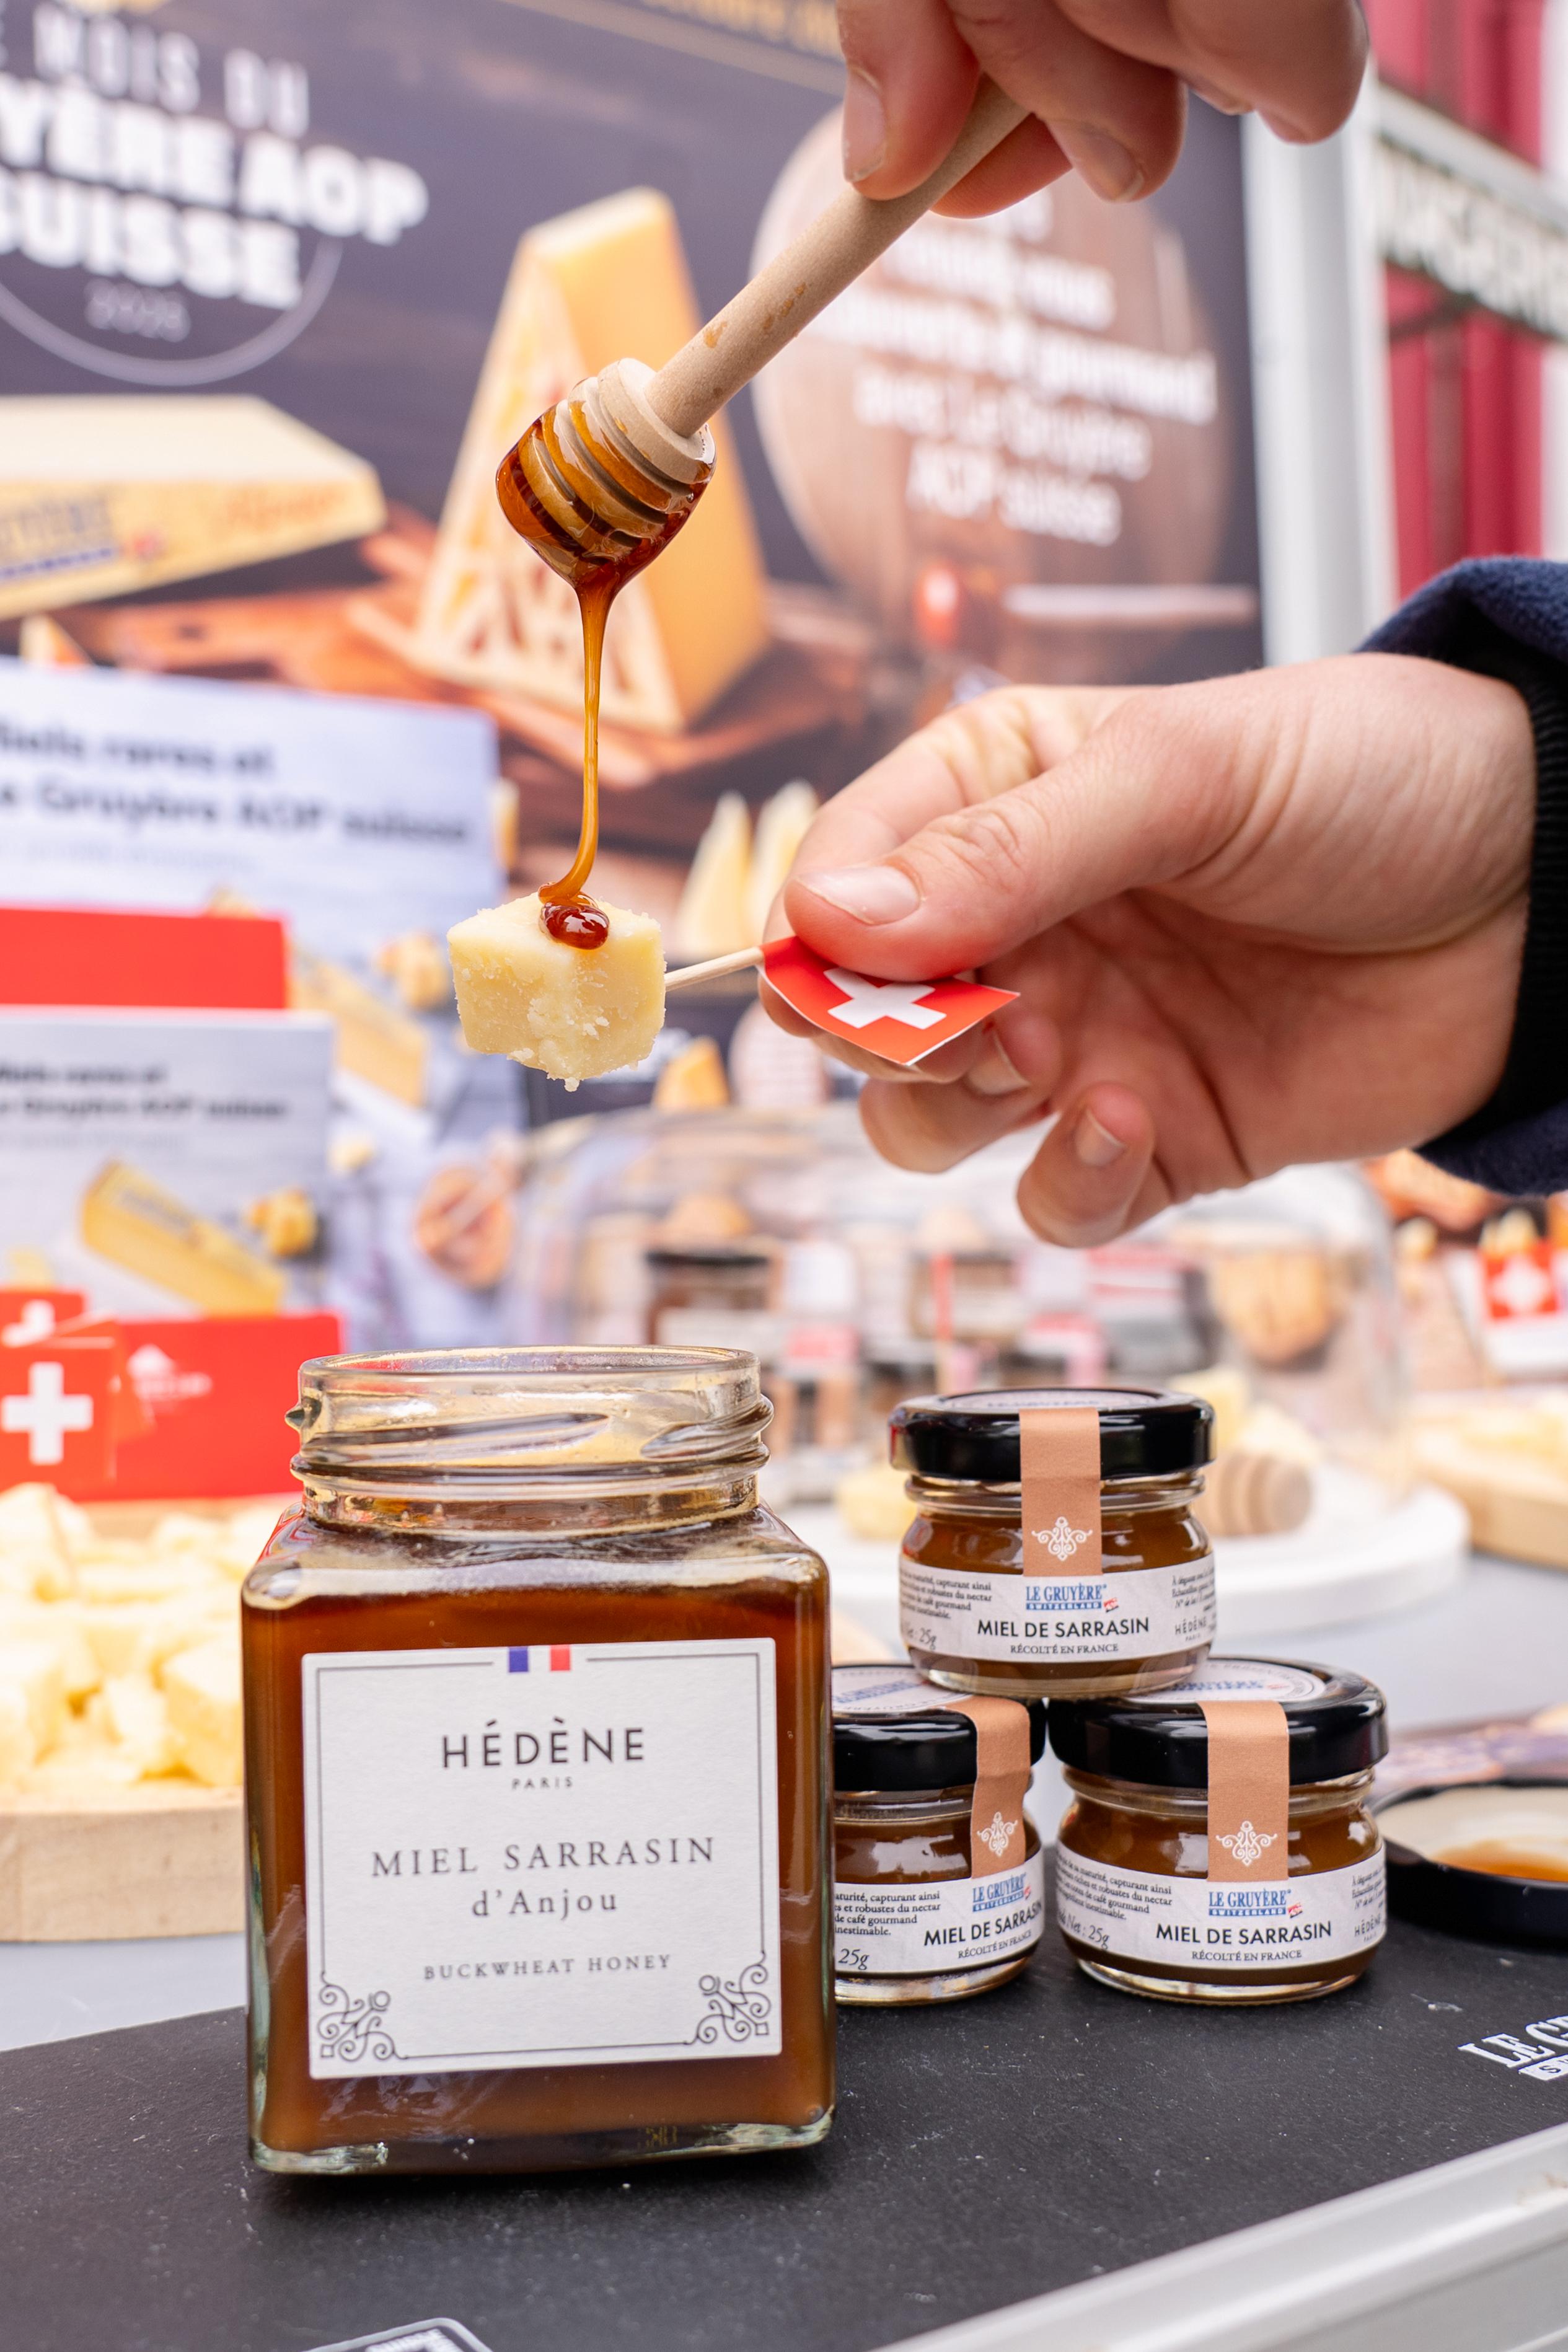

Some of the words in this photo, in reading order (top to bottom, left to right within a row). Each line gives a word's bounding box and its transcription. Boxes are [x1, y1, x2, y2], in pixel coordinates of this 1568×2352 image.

[239, 130, 429, 246] AOP
[972, 1582, 992, 1590] ainsi
[1026, 1586, 1041, 1601] LE
[955, 1591, 964, 1599] du
[935, 1600, 971, 1611] gourmand
[977, 1619, 1018, 1637] MIEL
[1024, 1622, 1049, 1637] DE
[1055, 1617, 1148, 1637] SARRASIN
[919, 1627, 936, 1650] 25g
[1011, 1642, 1057, 1654] RÉCOLTÉ
[1061, 1645, 1075, 1654] EN
[1078, 1643, 1119, 1654] FRANCE
[443, 1716, 645, 1769] HÉDÈNE
[512, 1776, 573, 1790] PARIS
[371, 1847, 478, 1877] MIEL
[504, 1836, 715, 1871] SARRASIN
[1109, 1876, 1148, 1890] capturant
[1150, 1885, 1171, 1895] ainsi
[870, 1893, 916, 1905] capturant
[918, 1890, 940, 1900] ainsi
[972, 1886, 985, 1903] LE
[1098, 1885, 1130, 1898] robustes
[1132, 1892, 1142, 1901] du
[1145, 1895, 1173, 1906] nectar
[1209, 1891, 1224, 1907] LE
[855, 1903, 895, 1913] robustes
[897, 1903, 910, 1913] du
[912, 1903, 941, 1913] nectar
[1108, 1899, 1150, 1914] gourmand
[1209, 1907, 1286, 1916] SWITZERLAND
[847, 1914, 865, 1924] café
[868, 1914, 917, 1927] gourmand
[923, 1927, 966, 1946] MIEL
[971, 1921, 990, 1940] DE
[995, 1899, 1042, 1934] SARRASIN
[835, 1926, 891, 1936] inestimable.
[1088, 1925, 1110, 1950] 25g
[1156, 1924, 1200, 1944] MIEL
[1207, 1929, 1232, 1944] DE
[1239, 1921, 1331, 1944] SARRASIN
[958, 1942, 997, 1958] RÉCOLTÉ
[998, 1940, 1008, 1949] EN
[1010, 1929, 1031, 1946] FRANCE
[839, 1949, 870, 1970] 25g
[1192, 1949, 1240, 1961] RÉCOLTÉ
[1244, 1952, 1258, 1961] EN
[1261, 1949, 1302, 1961] FRANCE
[424, 1957, 575, 1981] BUCKWHEAT
[588, 1953, 672, 1973] HONEY
